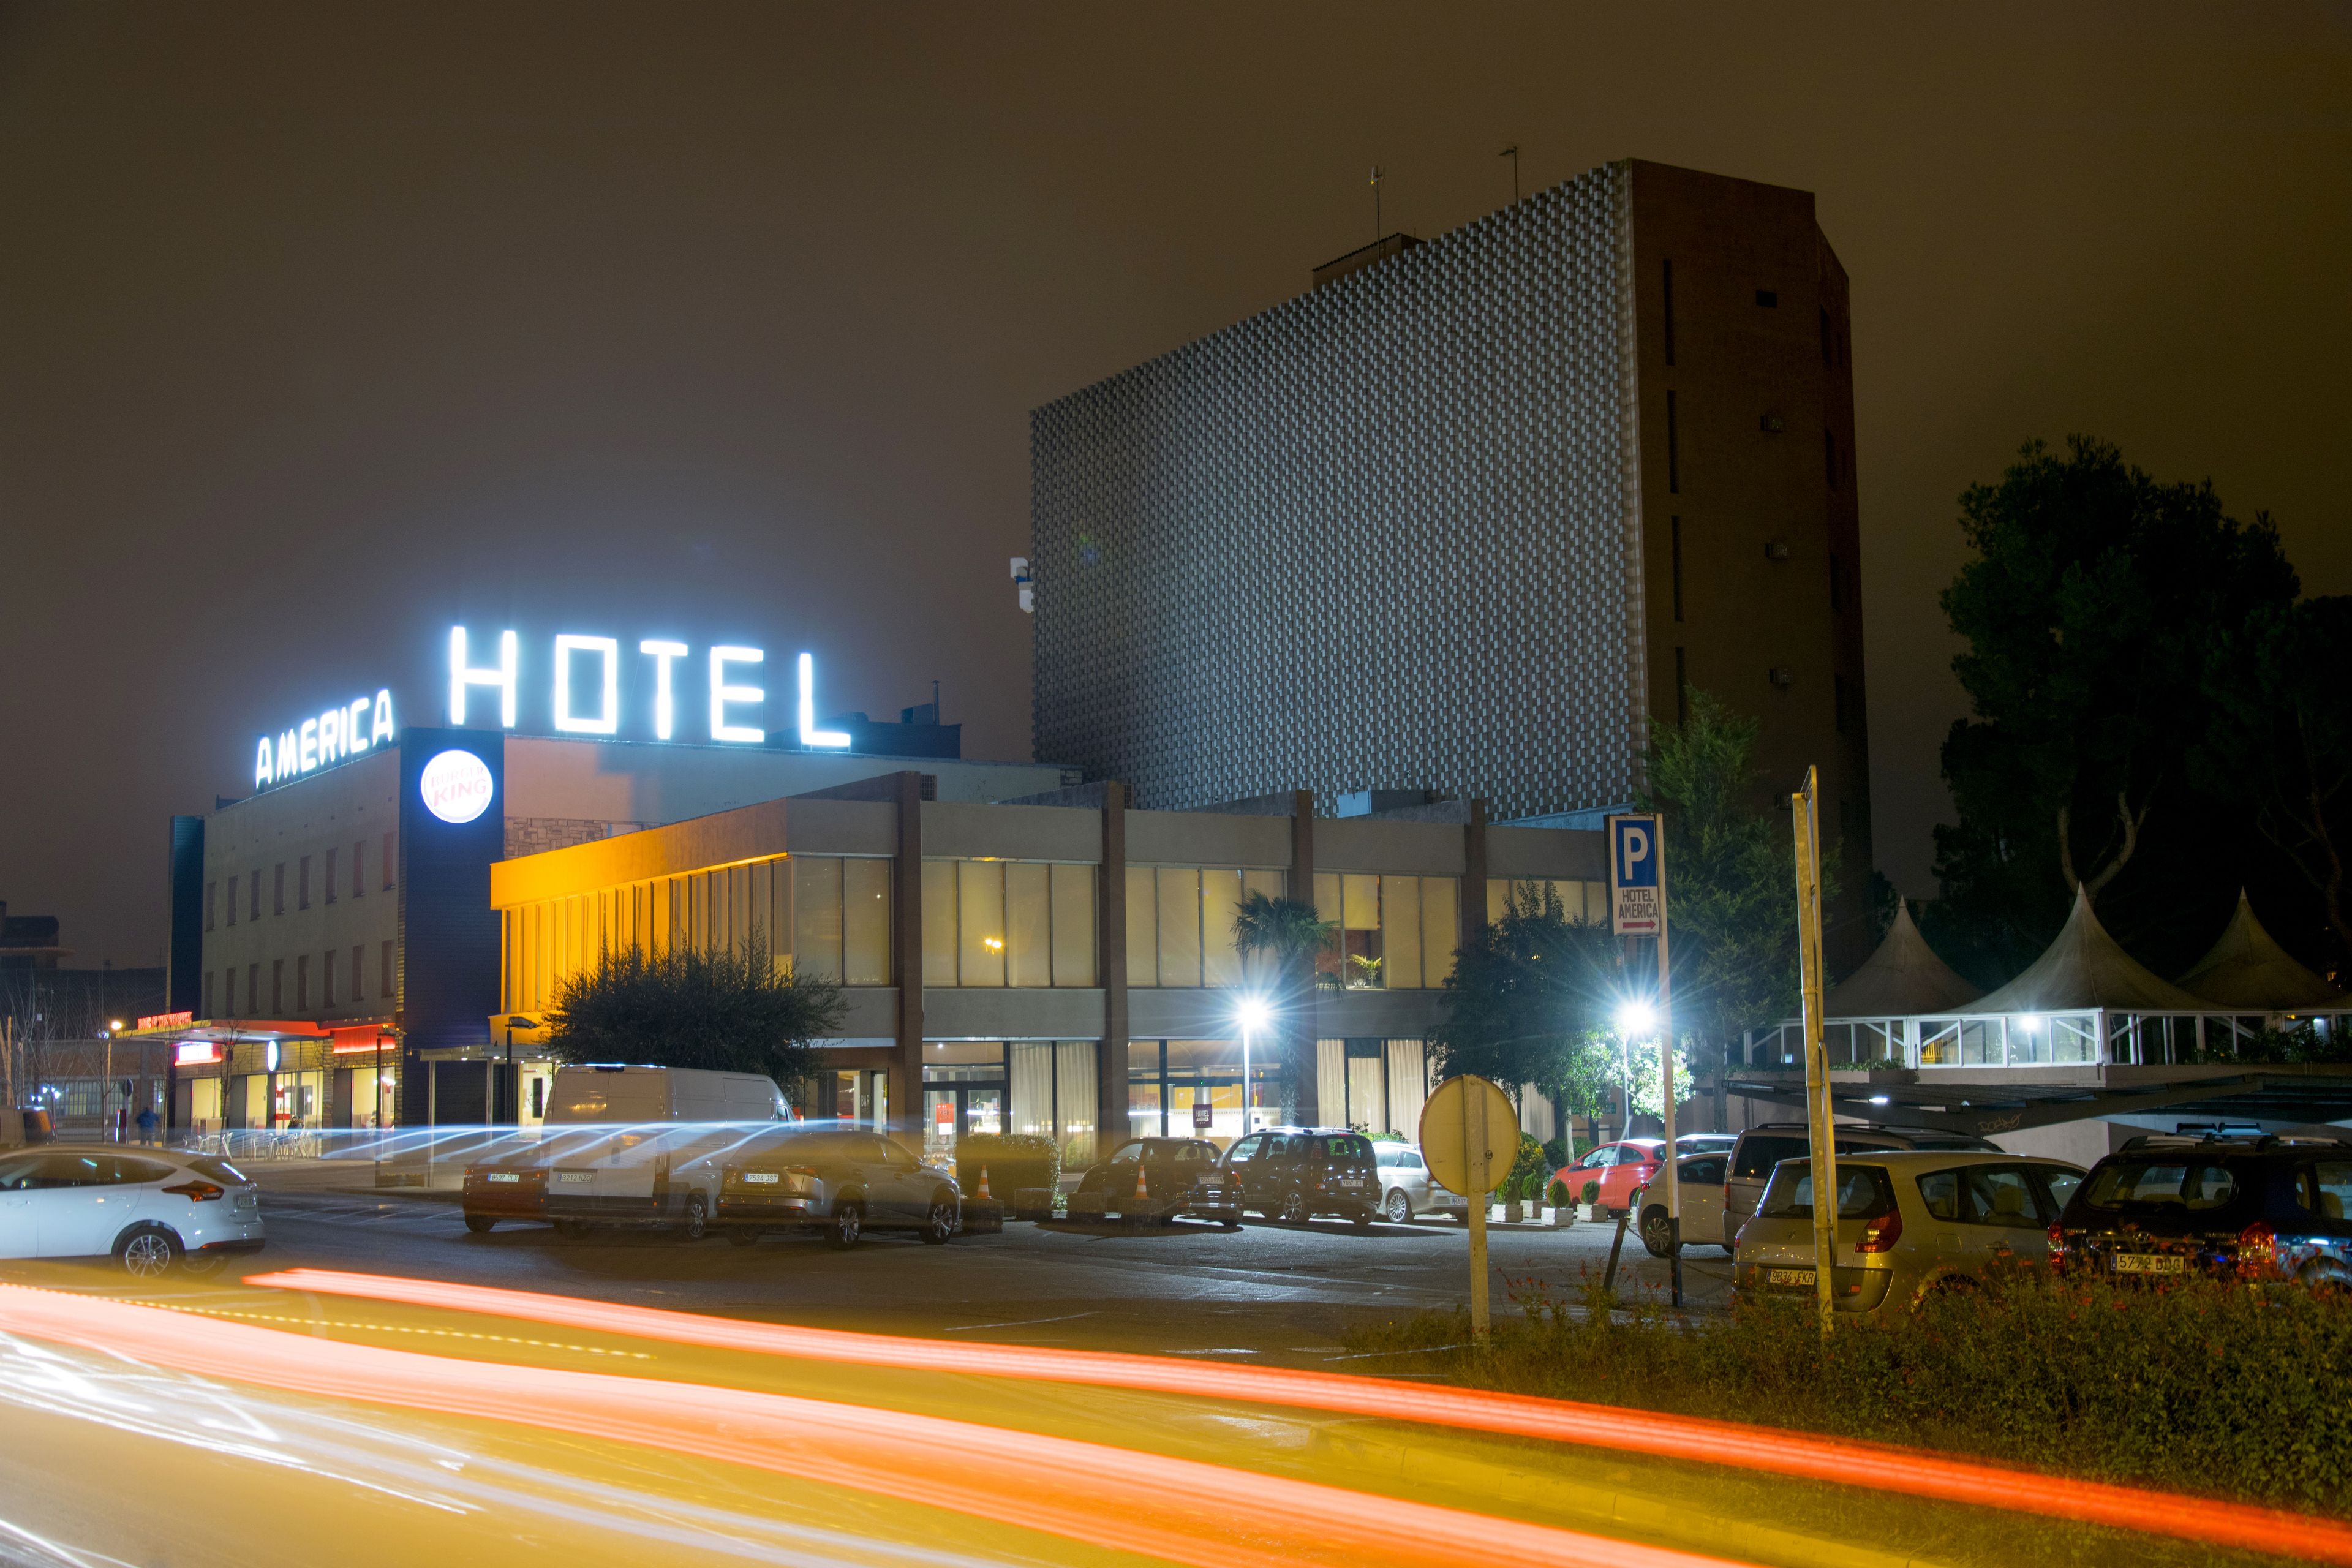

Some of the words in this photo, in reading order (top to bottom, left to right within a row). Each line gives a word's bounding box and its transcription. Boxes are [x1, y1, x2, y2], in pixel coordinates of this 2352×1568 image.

[451, 626, 851, 747] HOTEL
[255, 688, 393, 790] AMERICA
[431, 766, 484, 788] BURGER
[434, 778, 486, 807] KING
[1623, 827, 1648, 880] P
[1622, 889, 1654, 903] HOTEL
[1618, 903, 1659, 919] AMERICA
[861, 1095, 870, 1107] BAR
[2119, 1256, 2152, 1270] 5772
[1772, 1271, 1792, 1282] 9834
[1796, 1272, 1814, 1283] FKR
